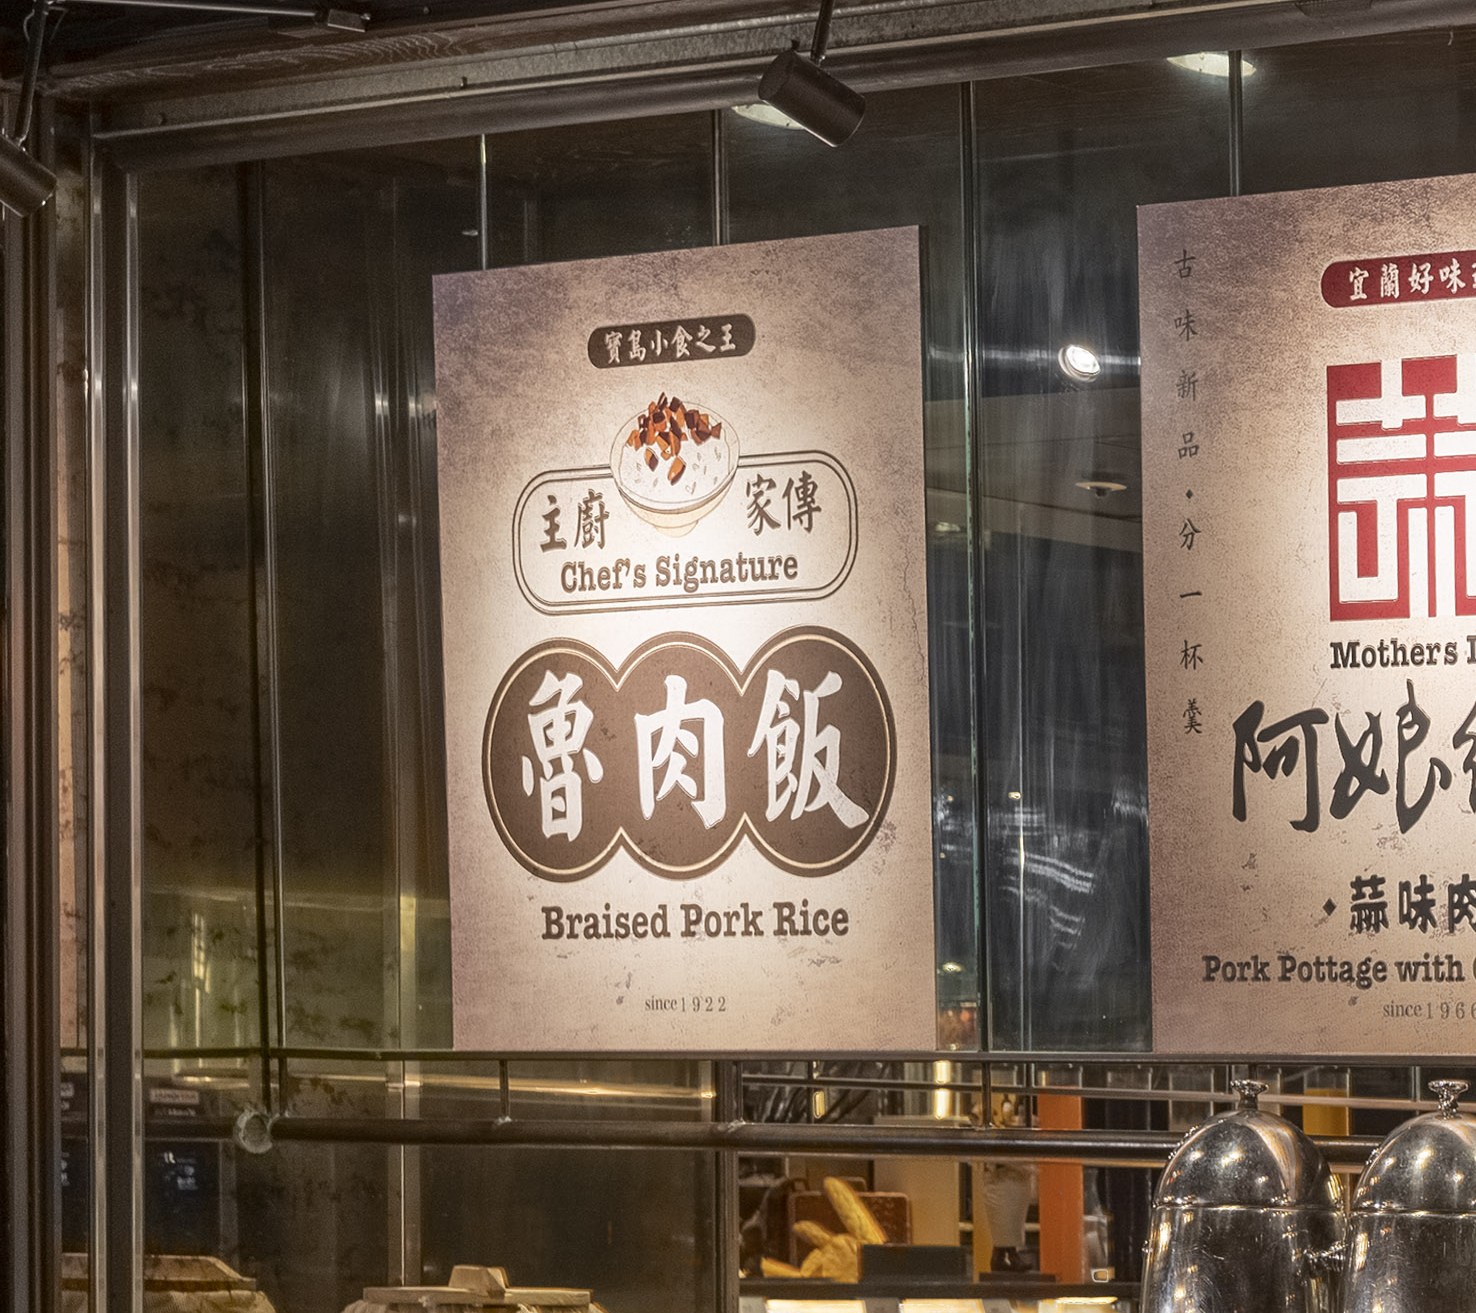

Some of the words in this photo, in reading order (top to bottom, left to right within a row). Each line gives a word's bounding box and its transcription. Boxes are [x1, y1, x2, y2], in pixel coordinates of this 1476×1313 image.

[604, 323, 736, 364] 寶島小食之王
[539, 488, 610, 553] 主廚
[746, 470, 822, 536] 家傳
[560, 557, 647, 594] Chef's
[655, 552, 798, 593] Signature
[1330, 638, 1458, 669] Mothers
[521, 669, 869, 843] 魯肉飯
[541, 902, 671, 940] Braised
[680, 902, 764, 938] Pork
[772, 898, 849, 936] Rice
[1202, 954, 1271, 983] Pork
[1277, 954, 1388, 989] Pottage
[1395, 952, 1465, 982] with
